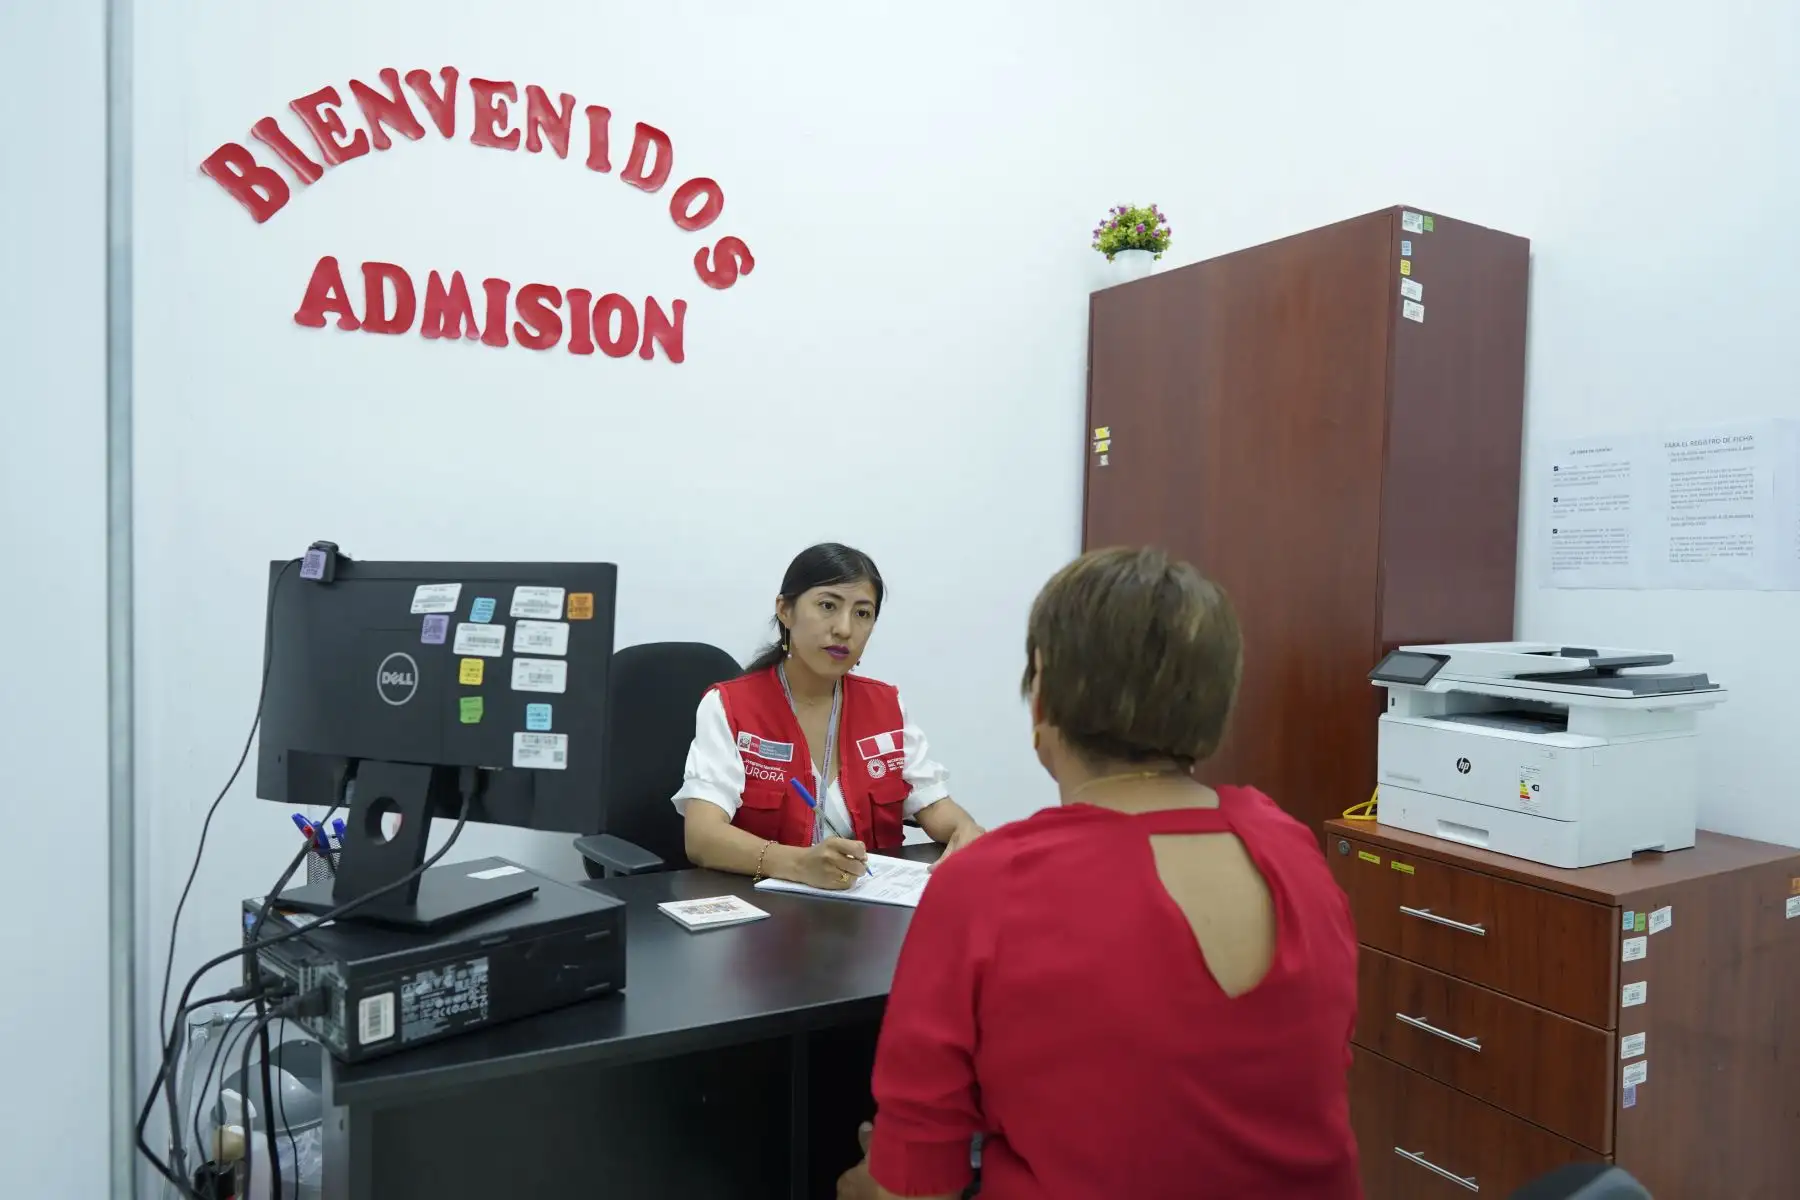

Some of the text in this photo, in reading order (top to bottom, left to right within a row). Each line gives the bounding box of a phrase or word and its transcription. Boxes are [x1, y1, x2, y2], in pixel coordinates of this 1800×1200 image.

[200, 66, 754, 290] BIENVENIDOS
[294, 256, 688, 363] ADMISION
[1733, 435, 1753, 443] FICHA
[381, 671, 414, 686] DELL
[745, 765, 785, 783] URORA
[1457, 757, 1471, 774] hp
